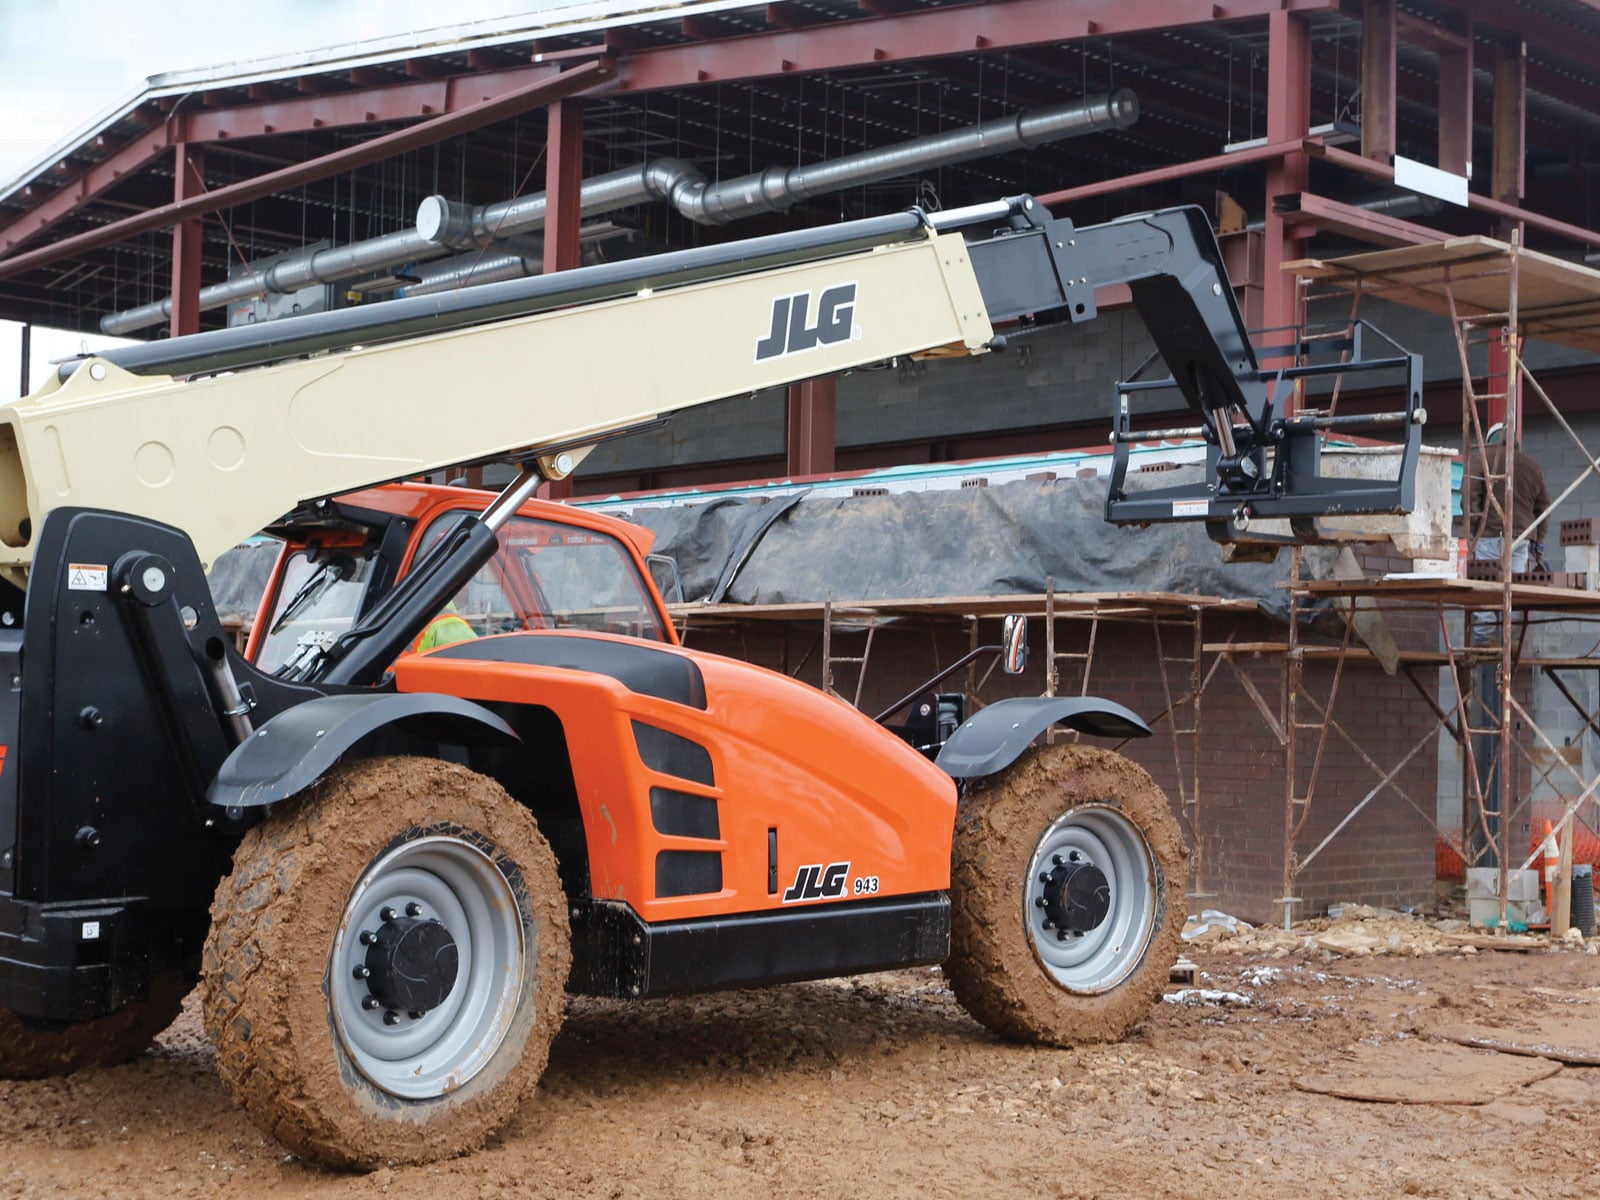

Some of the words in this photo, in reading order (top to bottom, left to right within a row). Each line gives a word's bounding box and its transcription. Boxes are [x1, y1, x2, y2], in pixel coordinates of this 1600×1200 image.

[755, 282, 858, 362] JLG
[783, 863, 850, 902] JLG
[854, 877, 879, 894] 943
